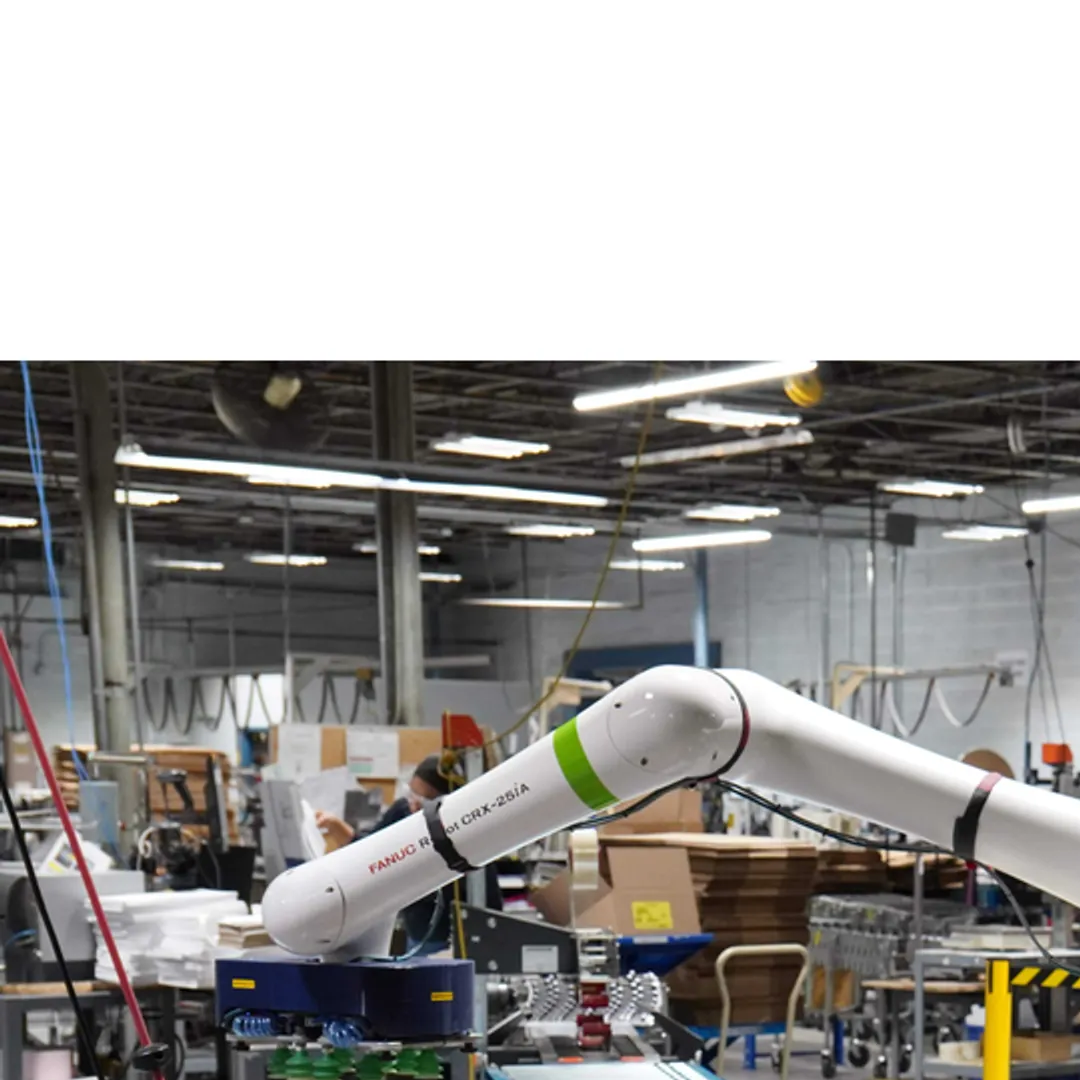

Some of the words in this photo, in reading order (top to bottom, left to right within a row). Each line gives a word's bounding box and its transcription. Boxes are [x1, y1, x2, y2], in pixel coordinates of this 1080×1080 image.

[368, 844, 417, 874] FANUC
[418, 823, 460, 849] Rot
[461, 782, 530, 826] CRX-25iA
